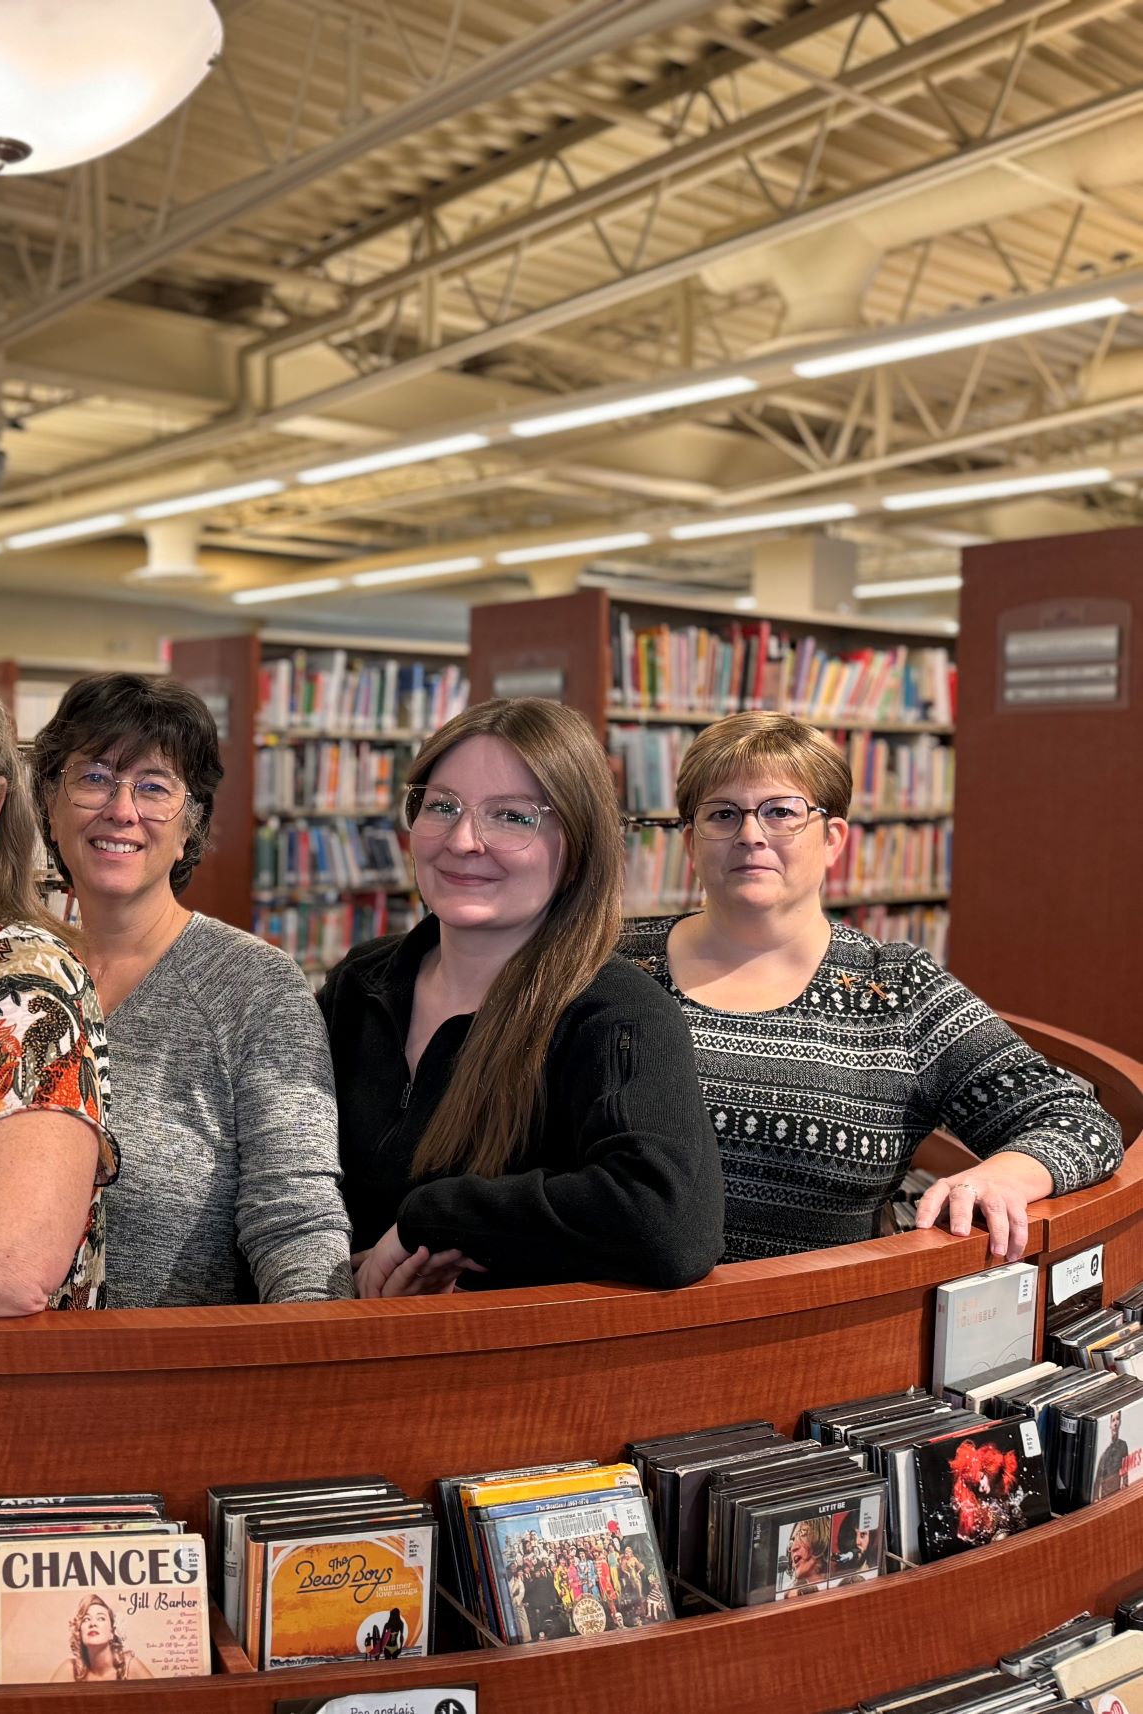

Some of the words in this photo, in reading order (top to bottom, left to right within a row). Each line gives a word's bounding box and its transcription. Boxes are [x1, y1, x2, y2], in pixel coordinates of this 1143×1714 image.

[819, 1504, 830, 1513] LET
[830, 1503, 837, 1511] IT
[837, 1501, 846, 1509] BE
[2, 1549, 199, 1589] CHANCES
[329, 1556, 349, 1572] The
[296, 1560, 350, 1592] Beach
[350, 1555, 393, 1602] Boys
[378, 1582, 412, 1591] summer
[376, 1590, 393, 1598] love
[394, 1587, 418, 1598] songs
[127, 1592, 149, 1616] Jill
[154, 1591, 198, 1611] Barber
